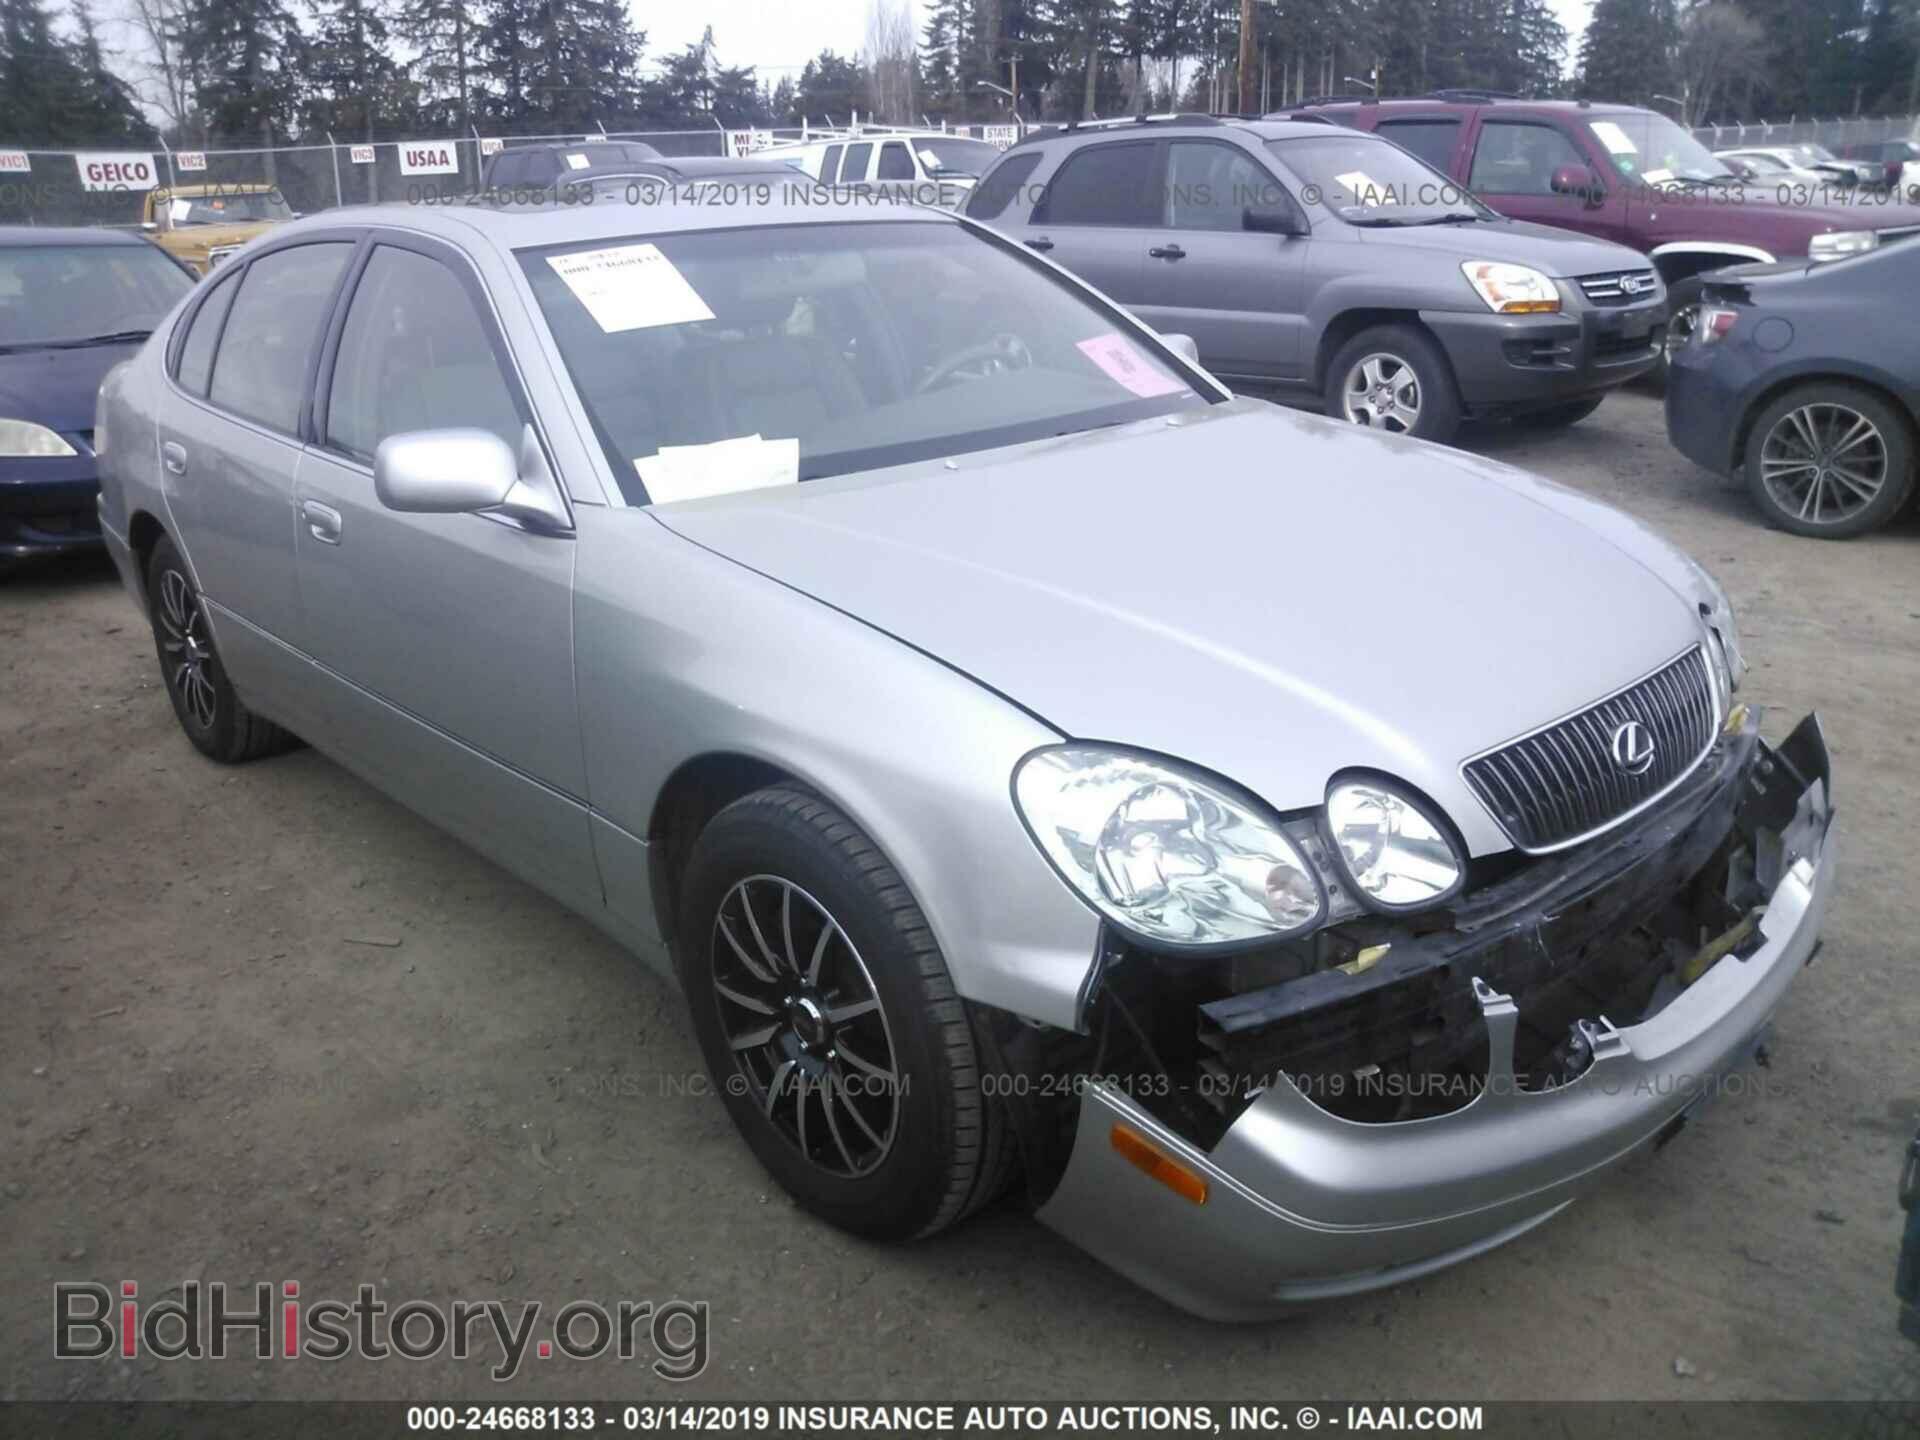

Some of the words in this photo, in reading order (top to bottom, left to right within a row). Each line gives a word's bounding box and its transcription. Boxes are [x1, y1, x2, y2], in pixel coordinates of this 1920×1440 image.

[987, 128, 1013, 138] STATE
[179, 154, 204, 167] VIC2
[406, 148, 450, 167] USAA
[87, 163, 150, 182] GEICO
